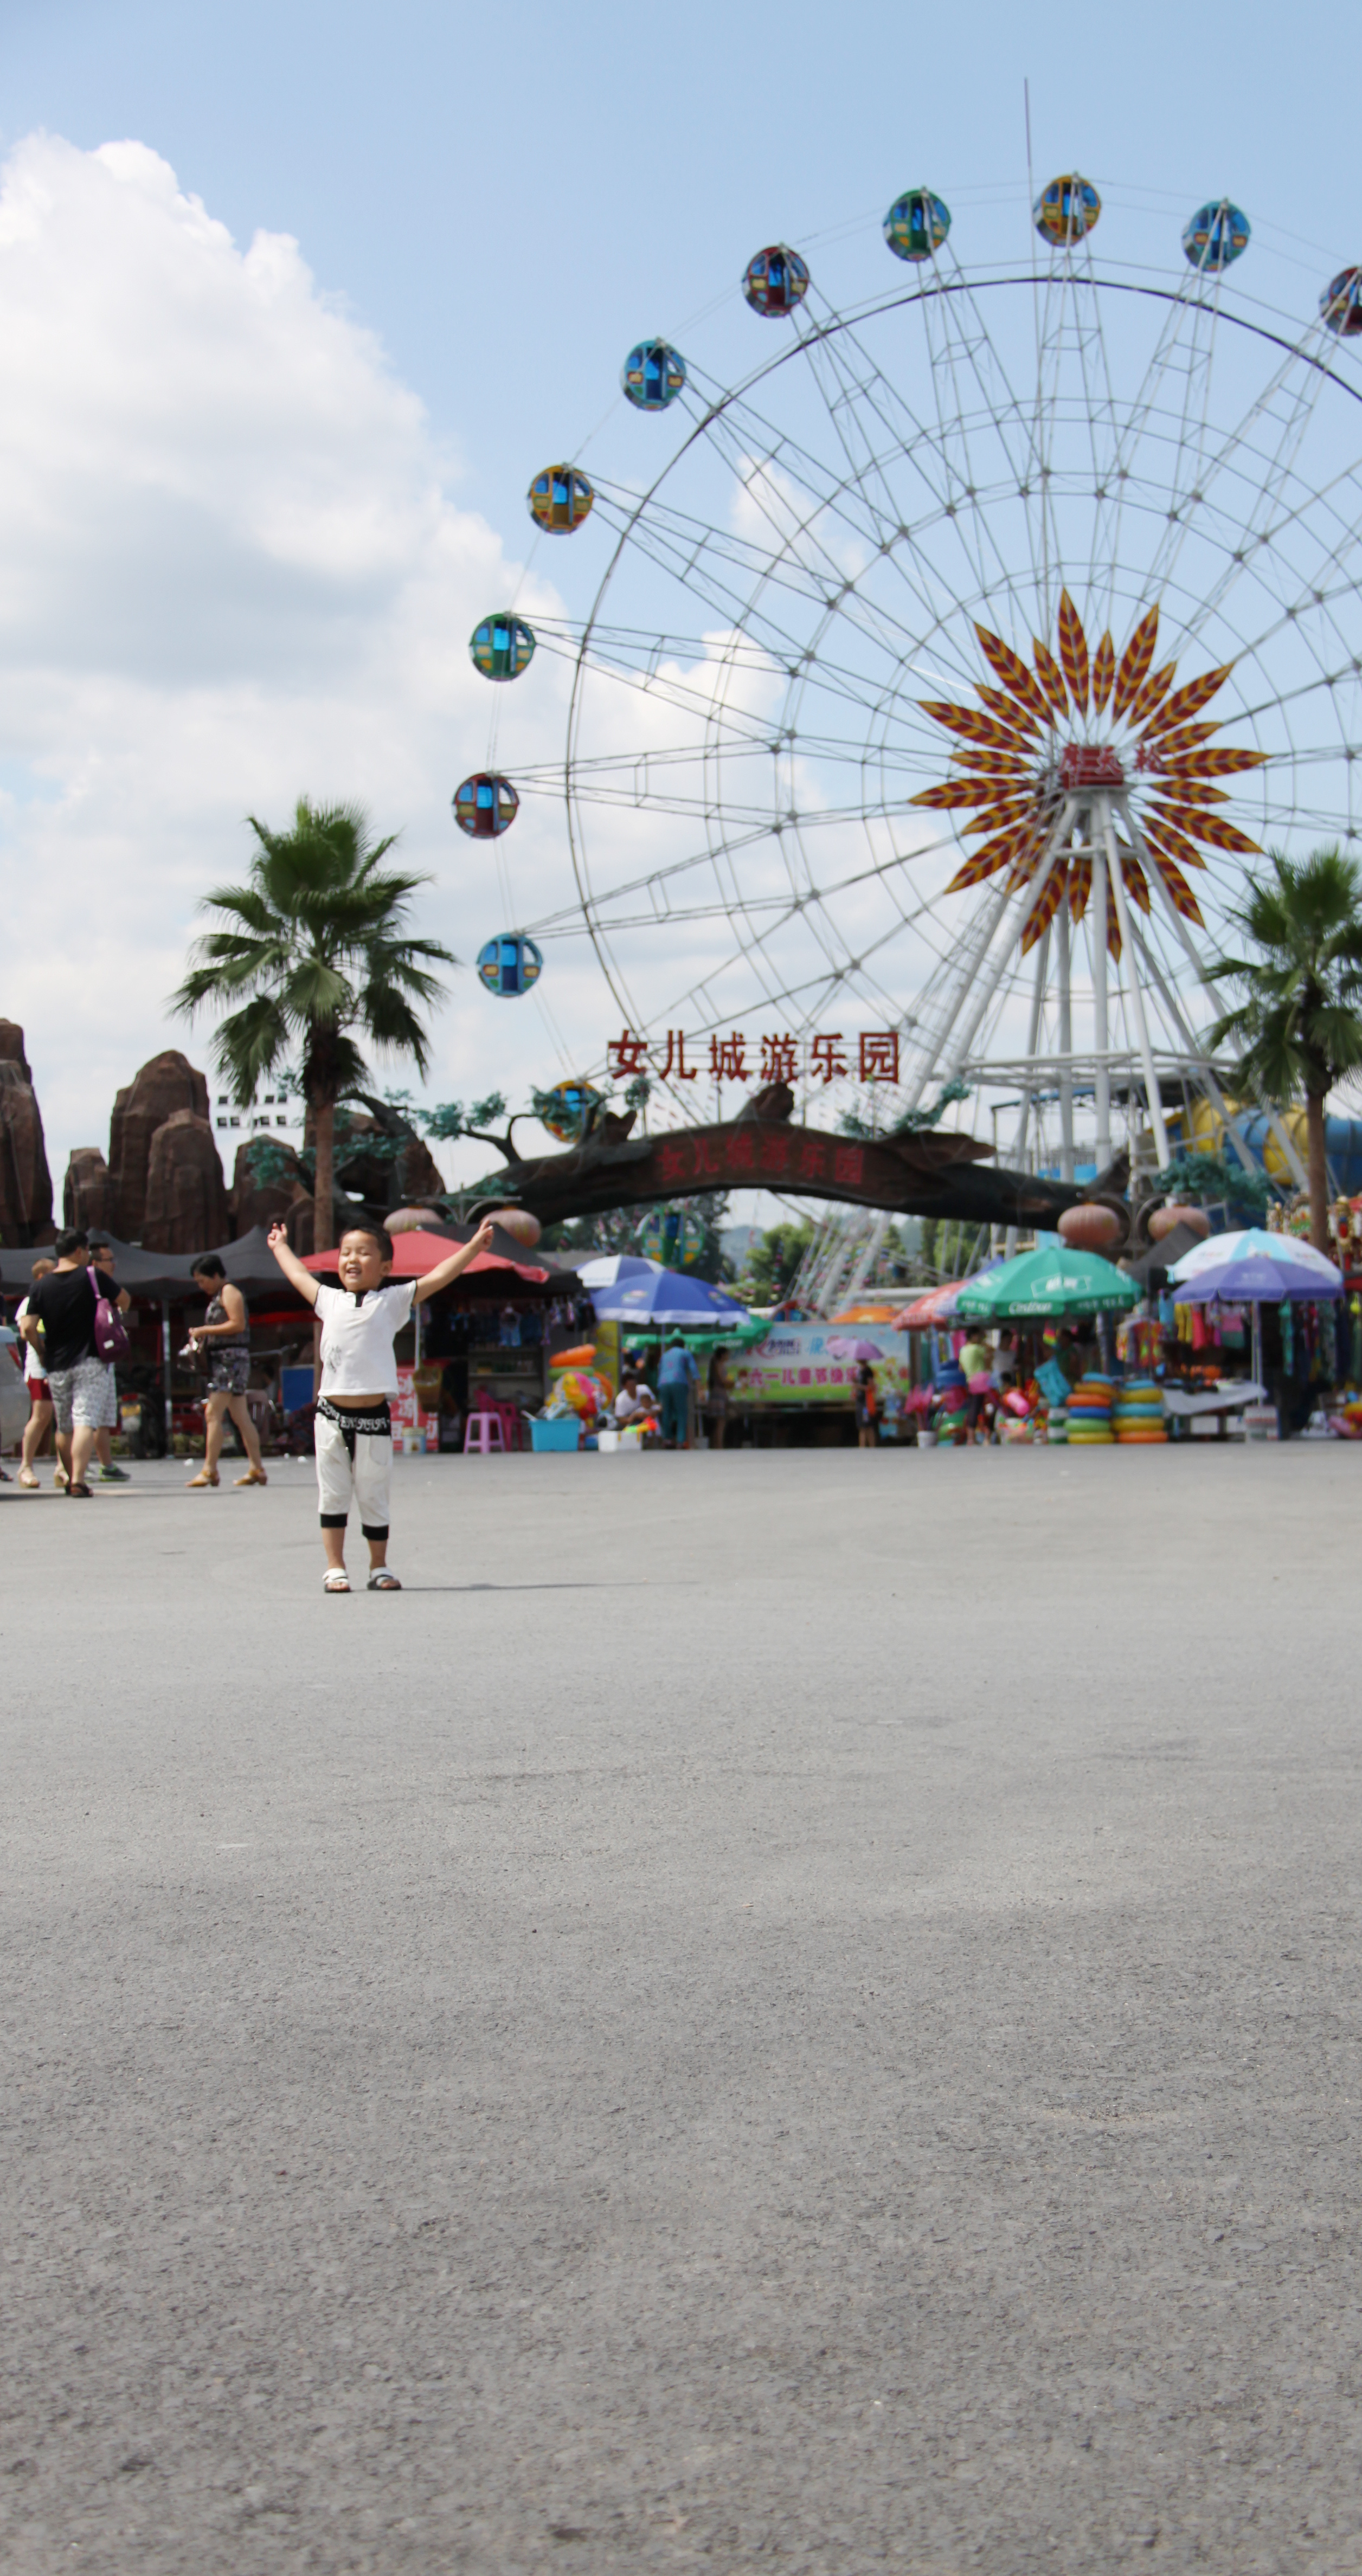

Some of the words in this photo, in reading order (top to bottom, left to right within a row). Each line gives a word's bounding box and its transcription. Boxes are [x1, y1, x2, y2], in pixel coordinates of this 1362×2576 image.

[608, 1030, 899, 1084] 女儿城游乐园
[657, 1134, 865, 1184] 女儿城游乐园
